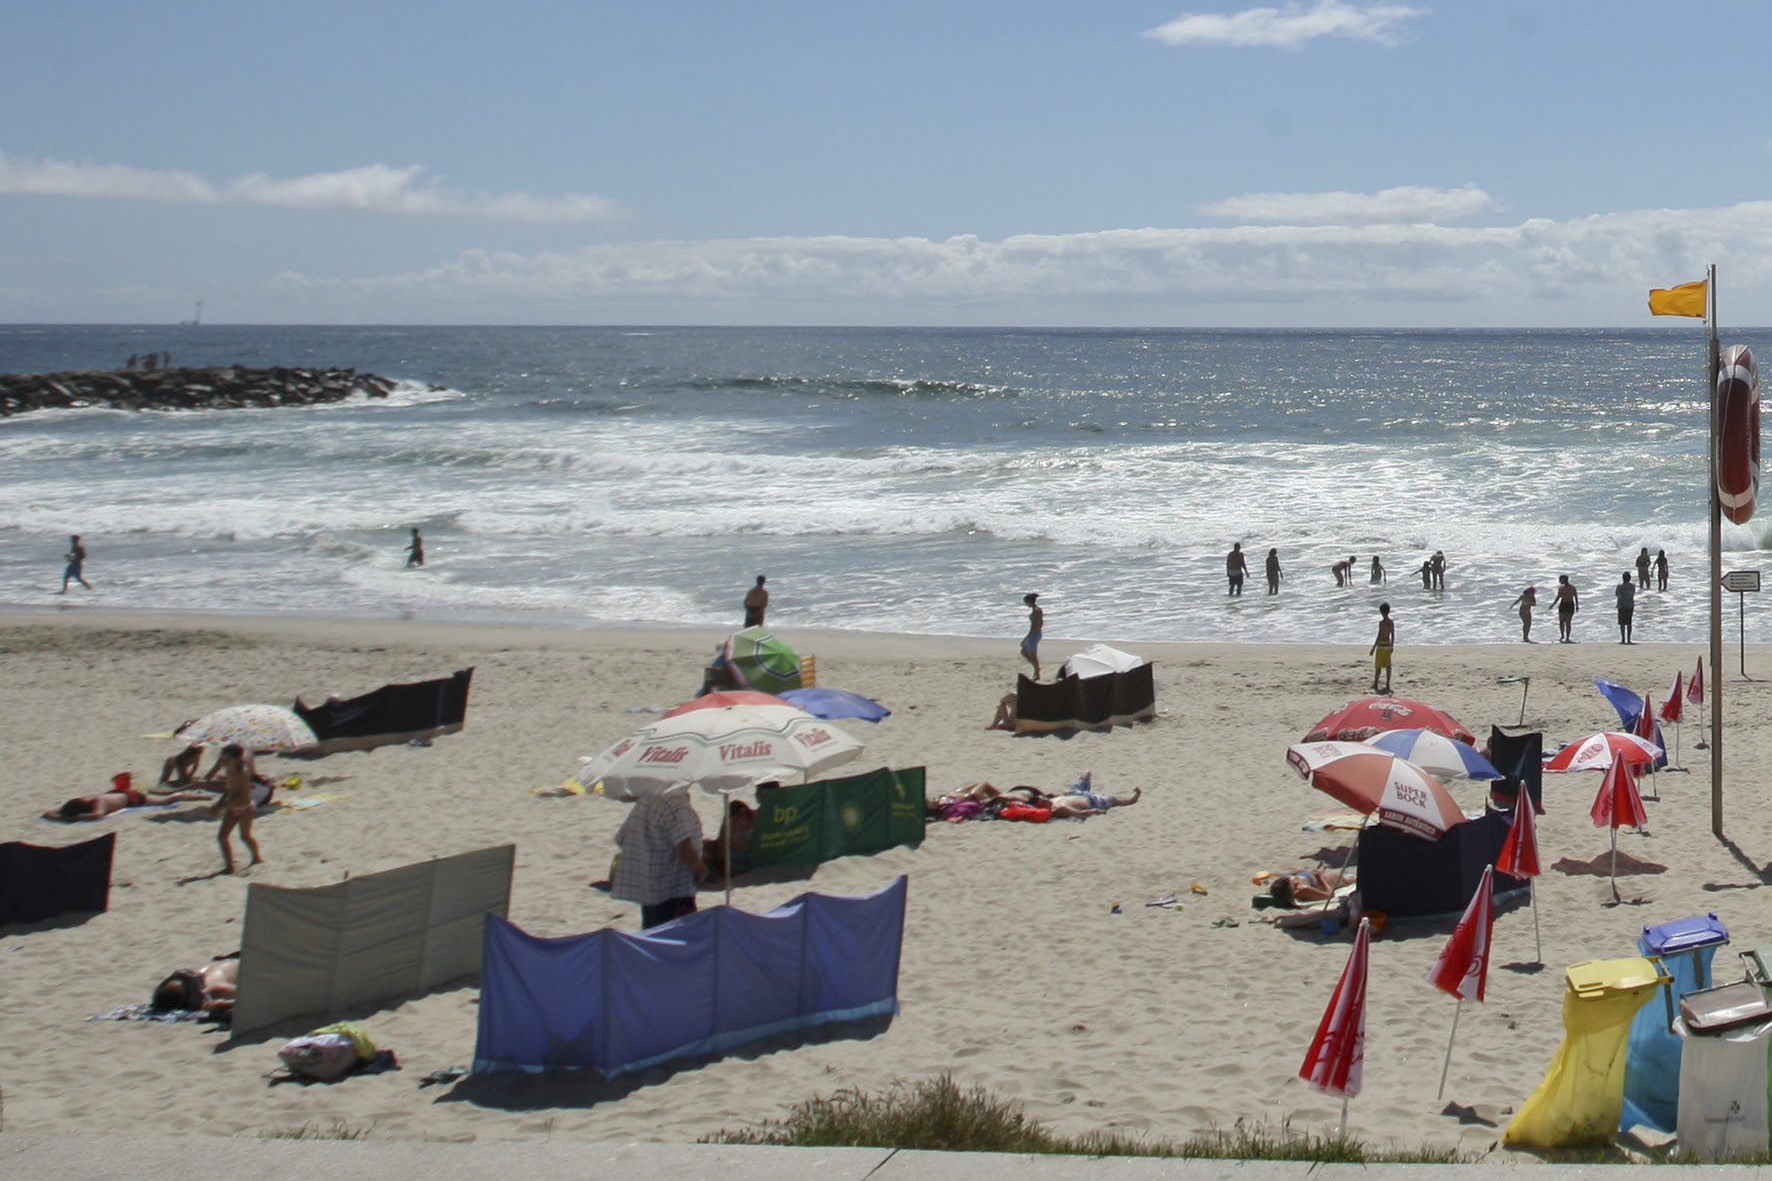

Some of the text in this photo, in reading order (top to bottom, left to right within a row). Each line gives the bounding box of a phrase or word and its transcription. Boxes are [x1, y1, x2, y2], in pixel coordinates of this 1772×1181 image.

[636, 746, 690, 763] Vitalis
[718, 739, 773, 762] Vitalis
[1394, 781, 1428, 802] SUPER
[1396, 790, 1427, 809] BOCK
[773, 804, 797, 826] bp
